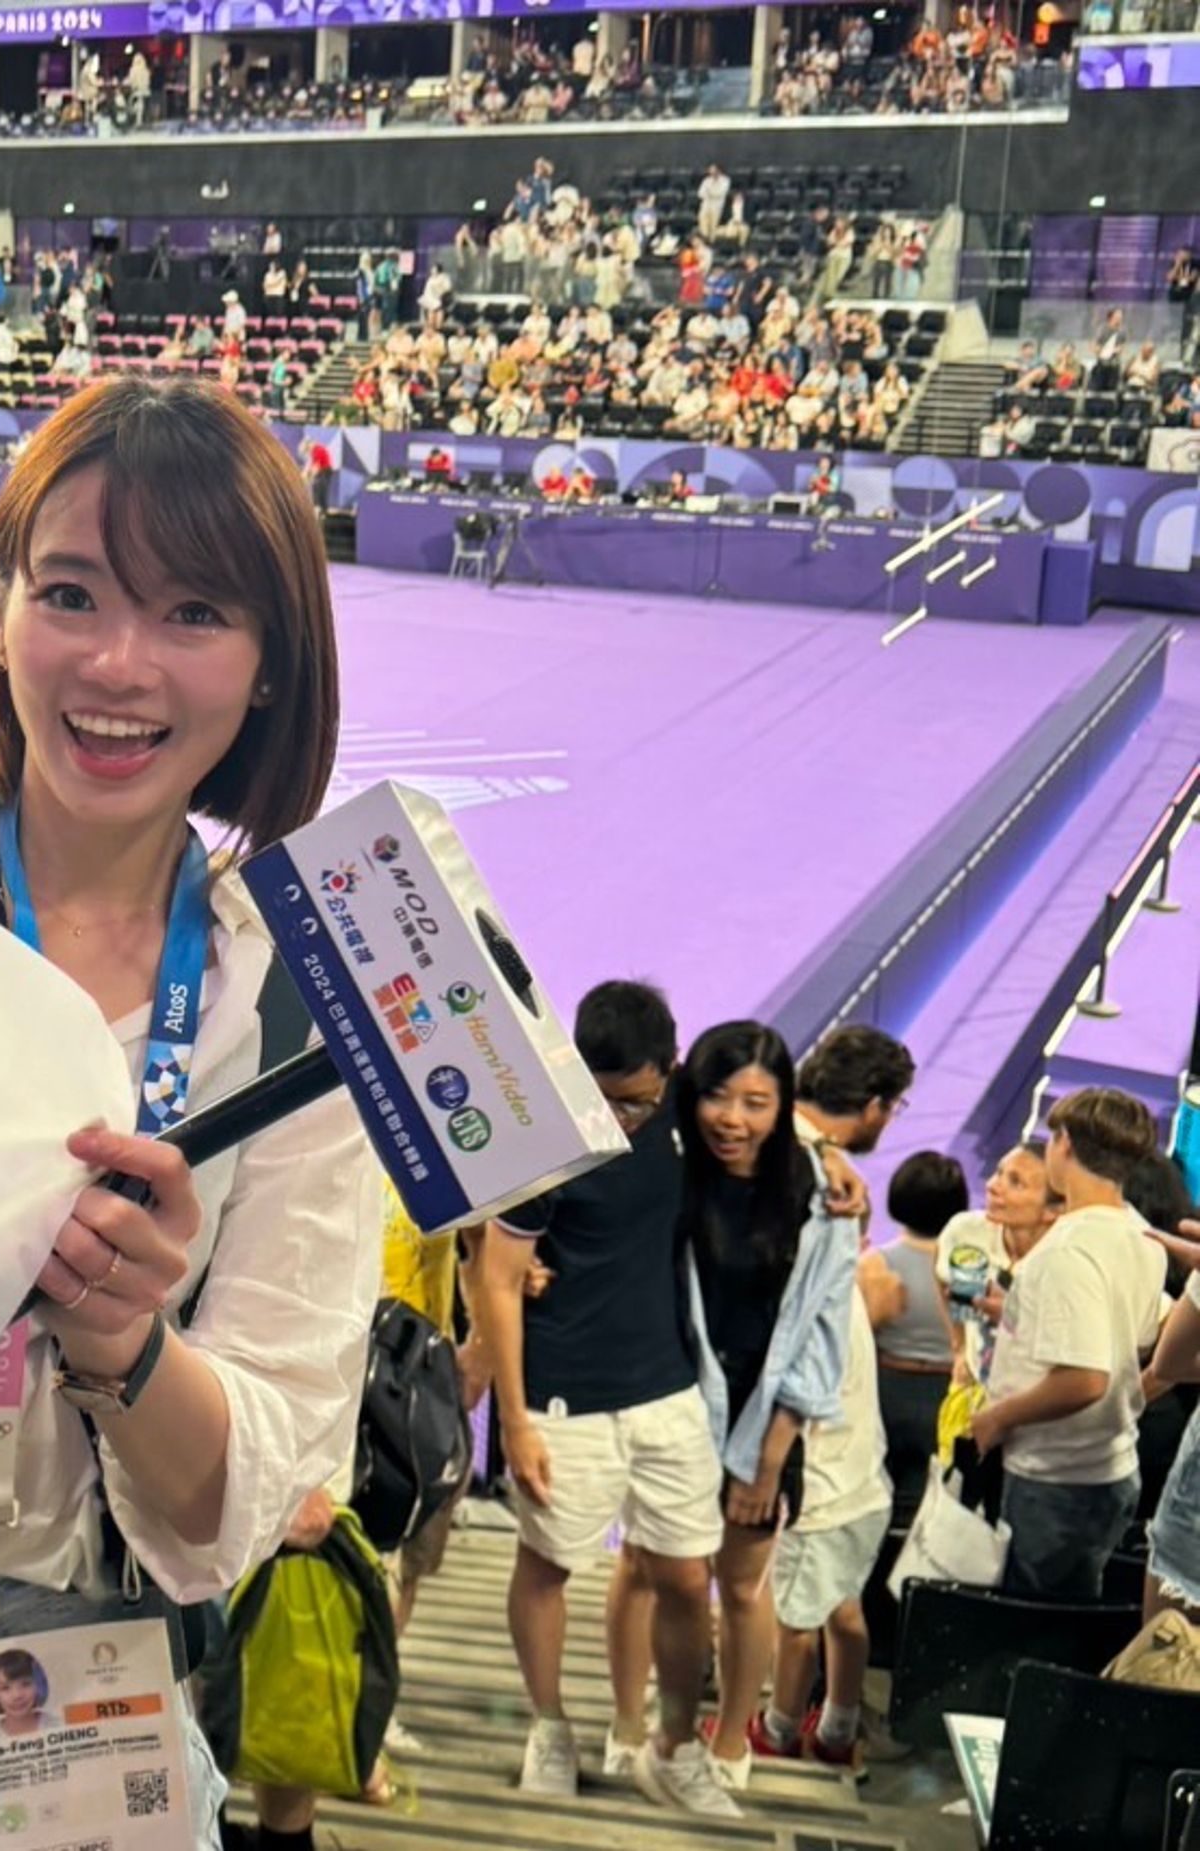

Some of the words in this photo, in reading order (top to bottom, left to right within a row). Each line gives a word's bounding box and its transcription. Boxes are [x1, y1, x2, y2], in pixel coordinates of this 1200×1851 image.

[51, 8, 102, 31] 2024
[389, 867, 439, 935] MOD
[326, 896, 376, 966] 公共電視
[393, 906, 434, 969] 中華電信
[303, 954, 336, 1001] 2024
[392, 973, 438, 1044] ELTA
[451, 1110, 488, 1148] CTS
[47, 1726, 98, 1745] CHENG
